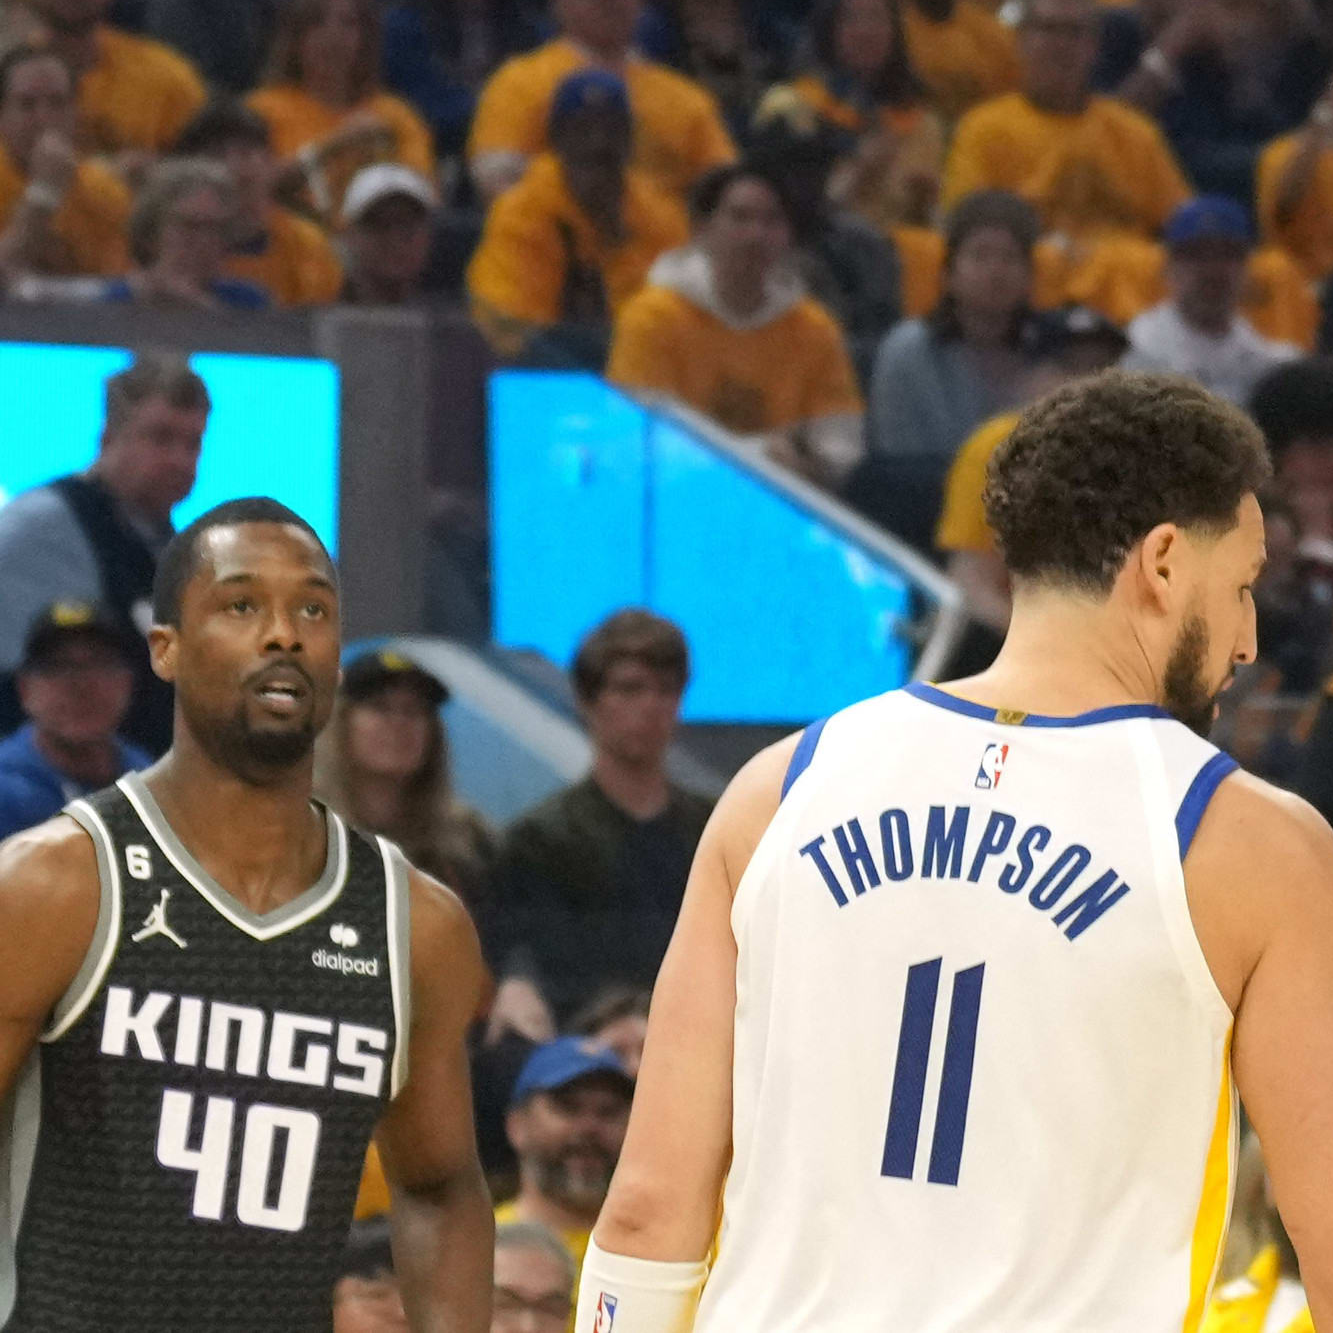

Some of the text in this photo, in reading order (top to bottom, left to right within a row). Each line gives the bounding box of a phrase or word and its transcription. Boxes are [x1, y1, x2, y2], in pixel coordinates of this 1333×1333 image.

[125, 844, 151, 880] 6
[799, 805, 1132, 942] THOMPSON
[311, 949, 379, 977] dialpad
[100, 986, 389, 1098] KINGS
[880, 956, 986, 1186] 11
[156, 1089, 321, 1233] 40
